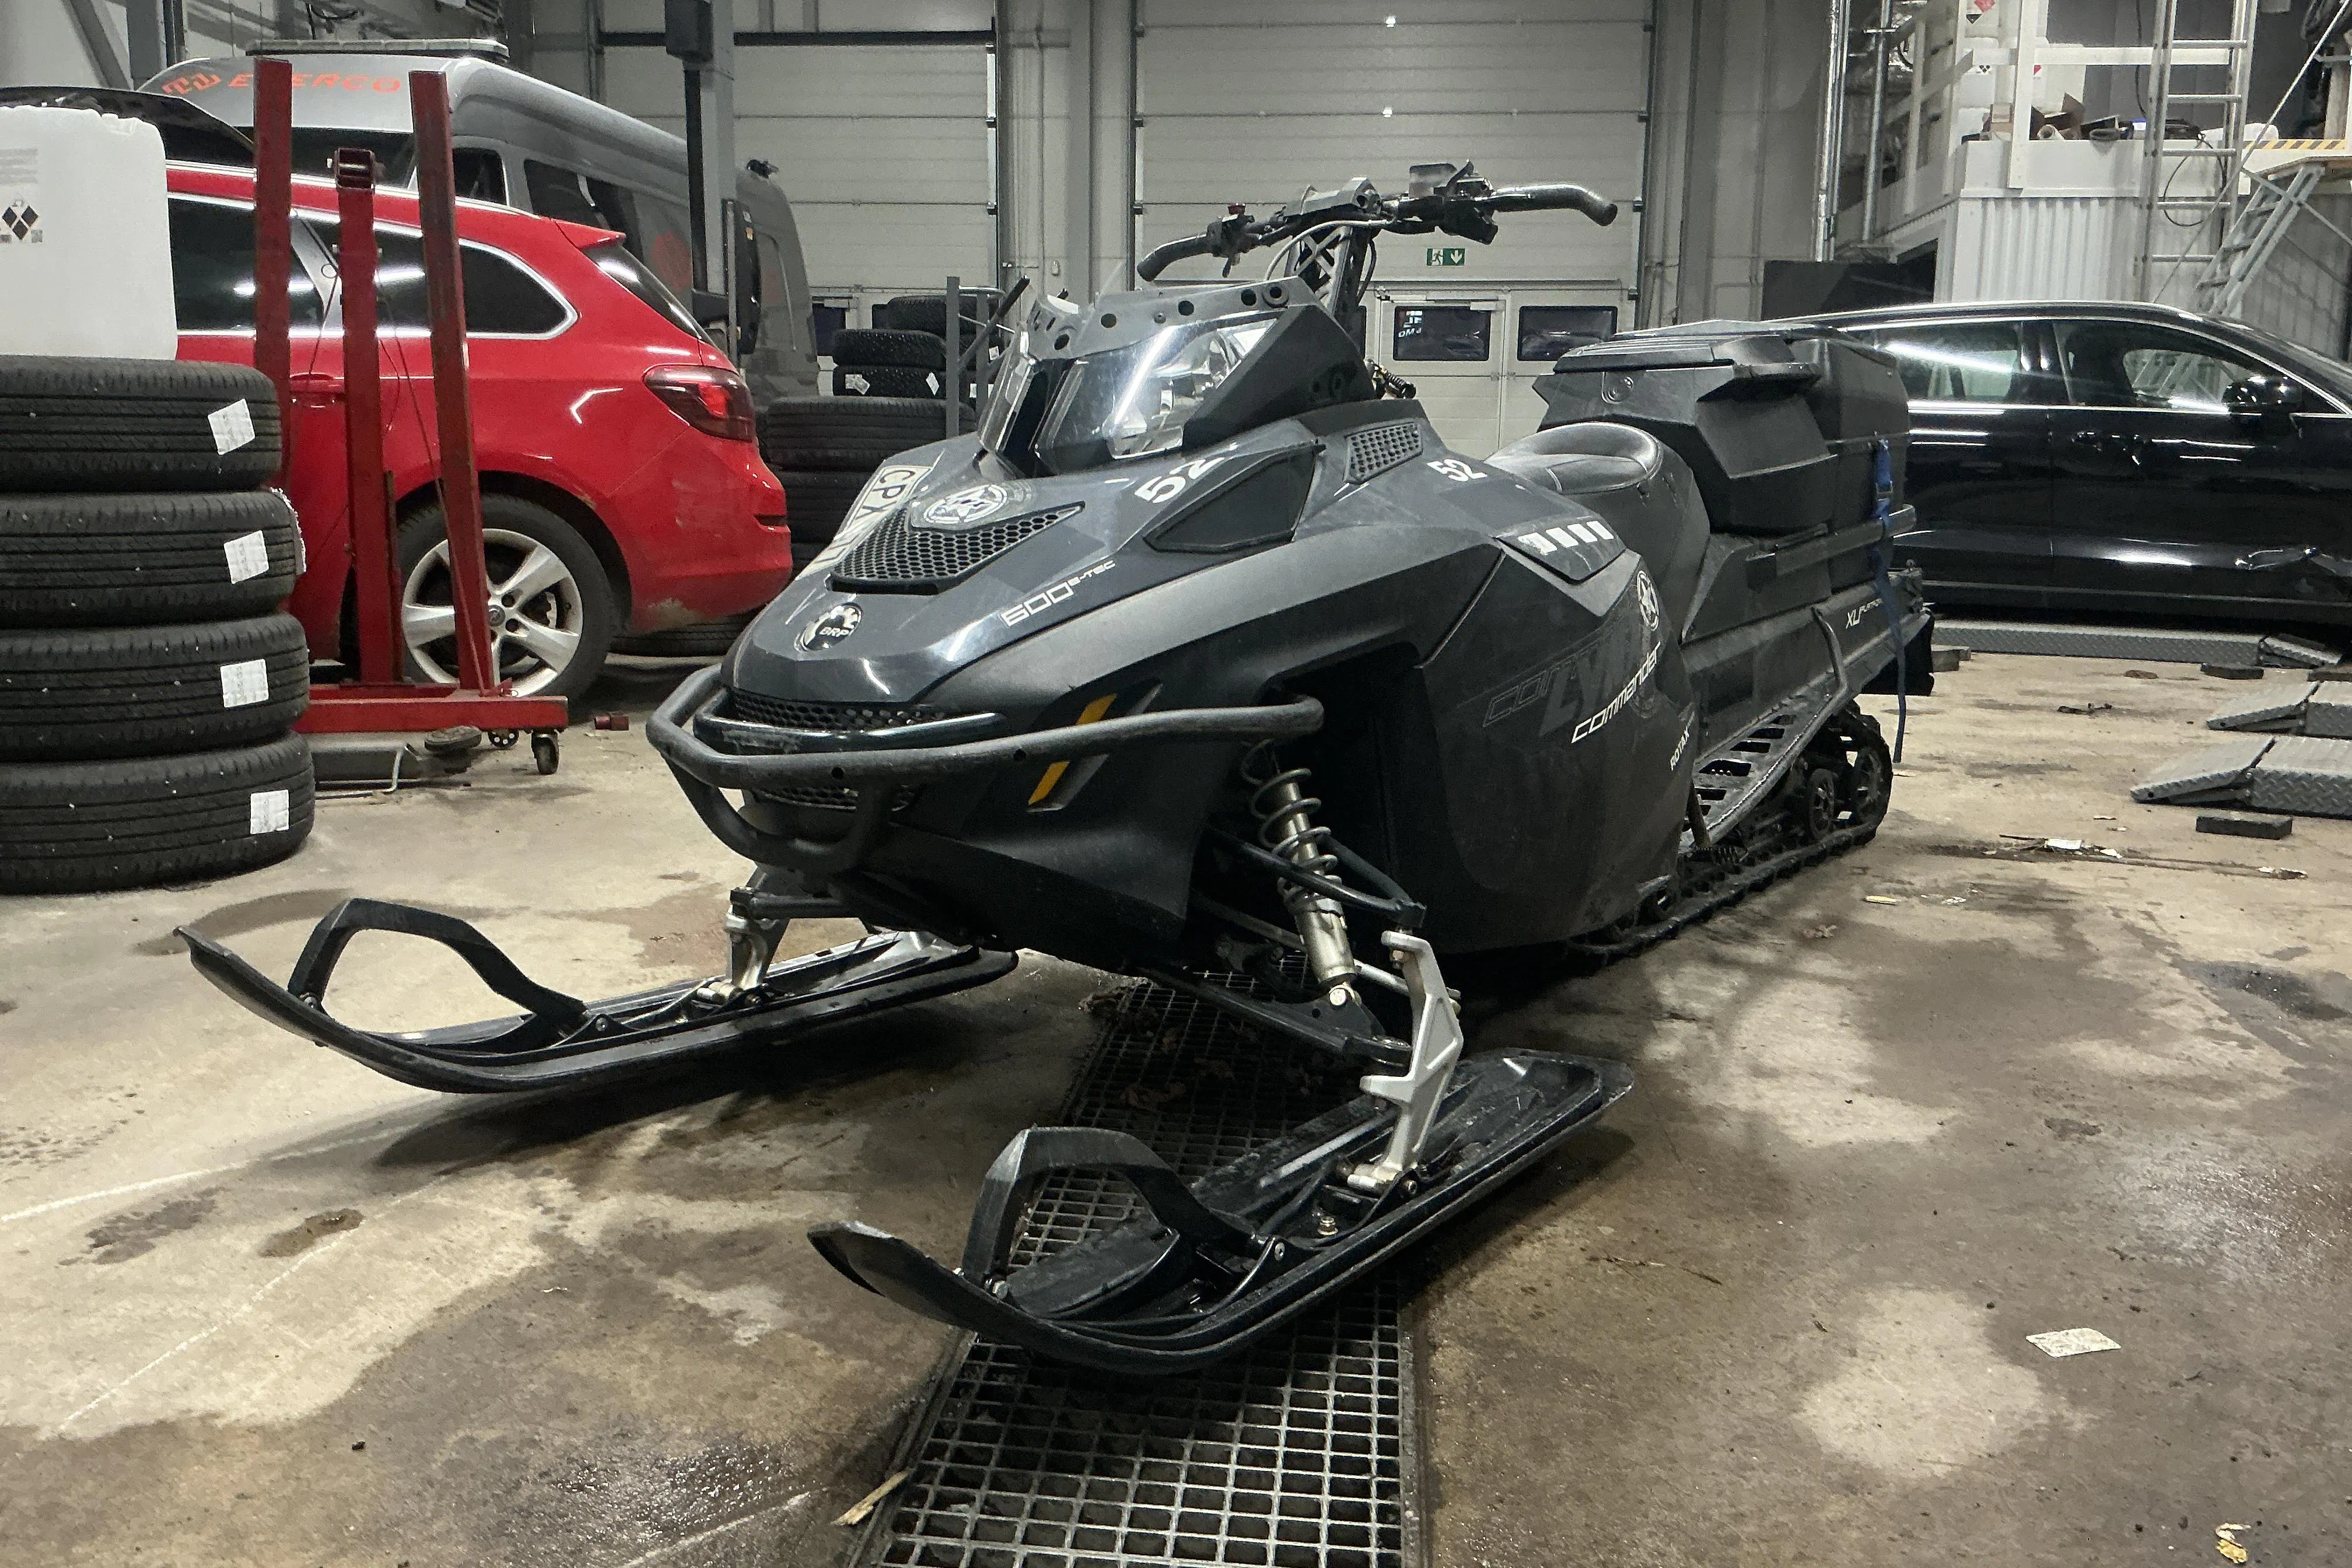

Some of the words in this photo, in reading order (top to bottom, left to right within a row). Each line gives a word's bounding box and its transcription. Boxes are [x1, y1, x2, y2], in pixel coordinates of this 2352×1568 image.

[229, 72, 401, 93] EERCO
[1134, 457, 1226, 503] 52
[1427, 459, 1488, 482] 52
[855, 470, 916, 520] CPX
[1000, 582, 1074, 627] 600
[819, 626, 850, 638] BRP
[1670, 726, 1690, 771] ROTAX
